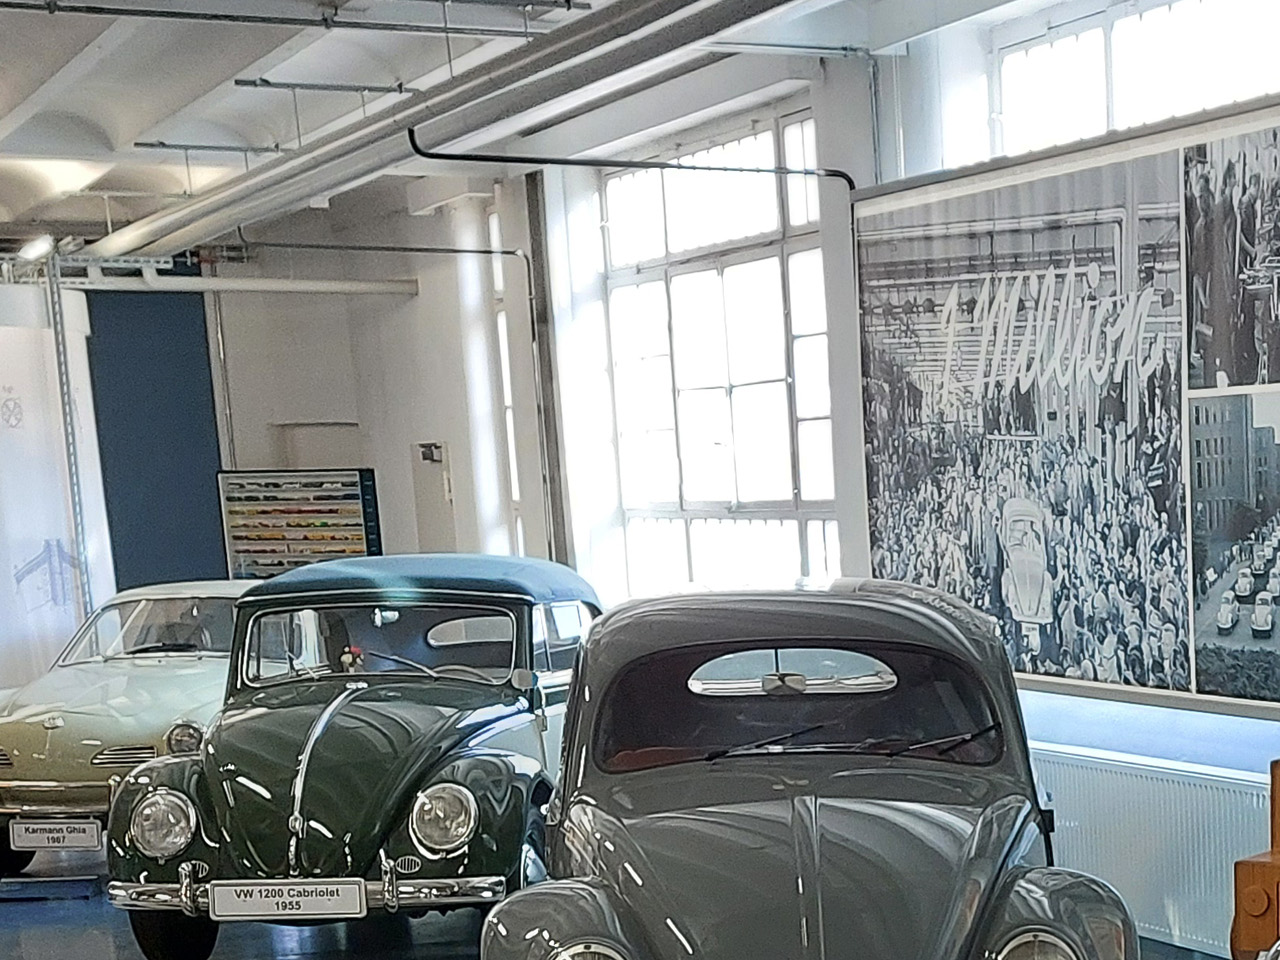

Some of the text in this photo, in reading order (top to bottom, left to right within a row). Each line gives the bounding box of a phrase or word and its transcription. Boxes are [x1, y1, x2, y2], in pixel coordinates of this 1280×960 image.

[24, 826, 64, 834] Karmann
[234, 888, 340, 899] VW 1200 Cabriolet
[274, 901, 301, 911] 1955
